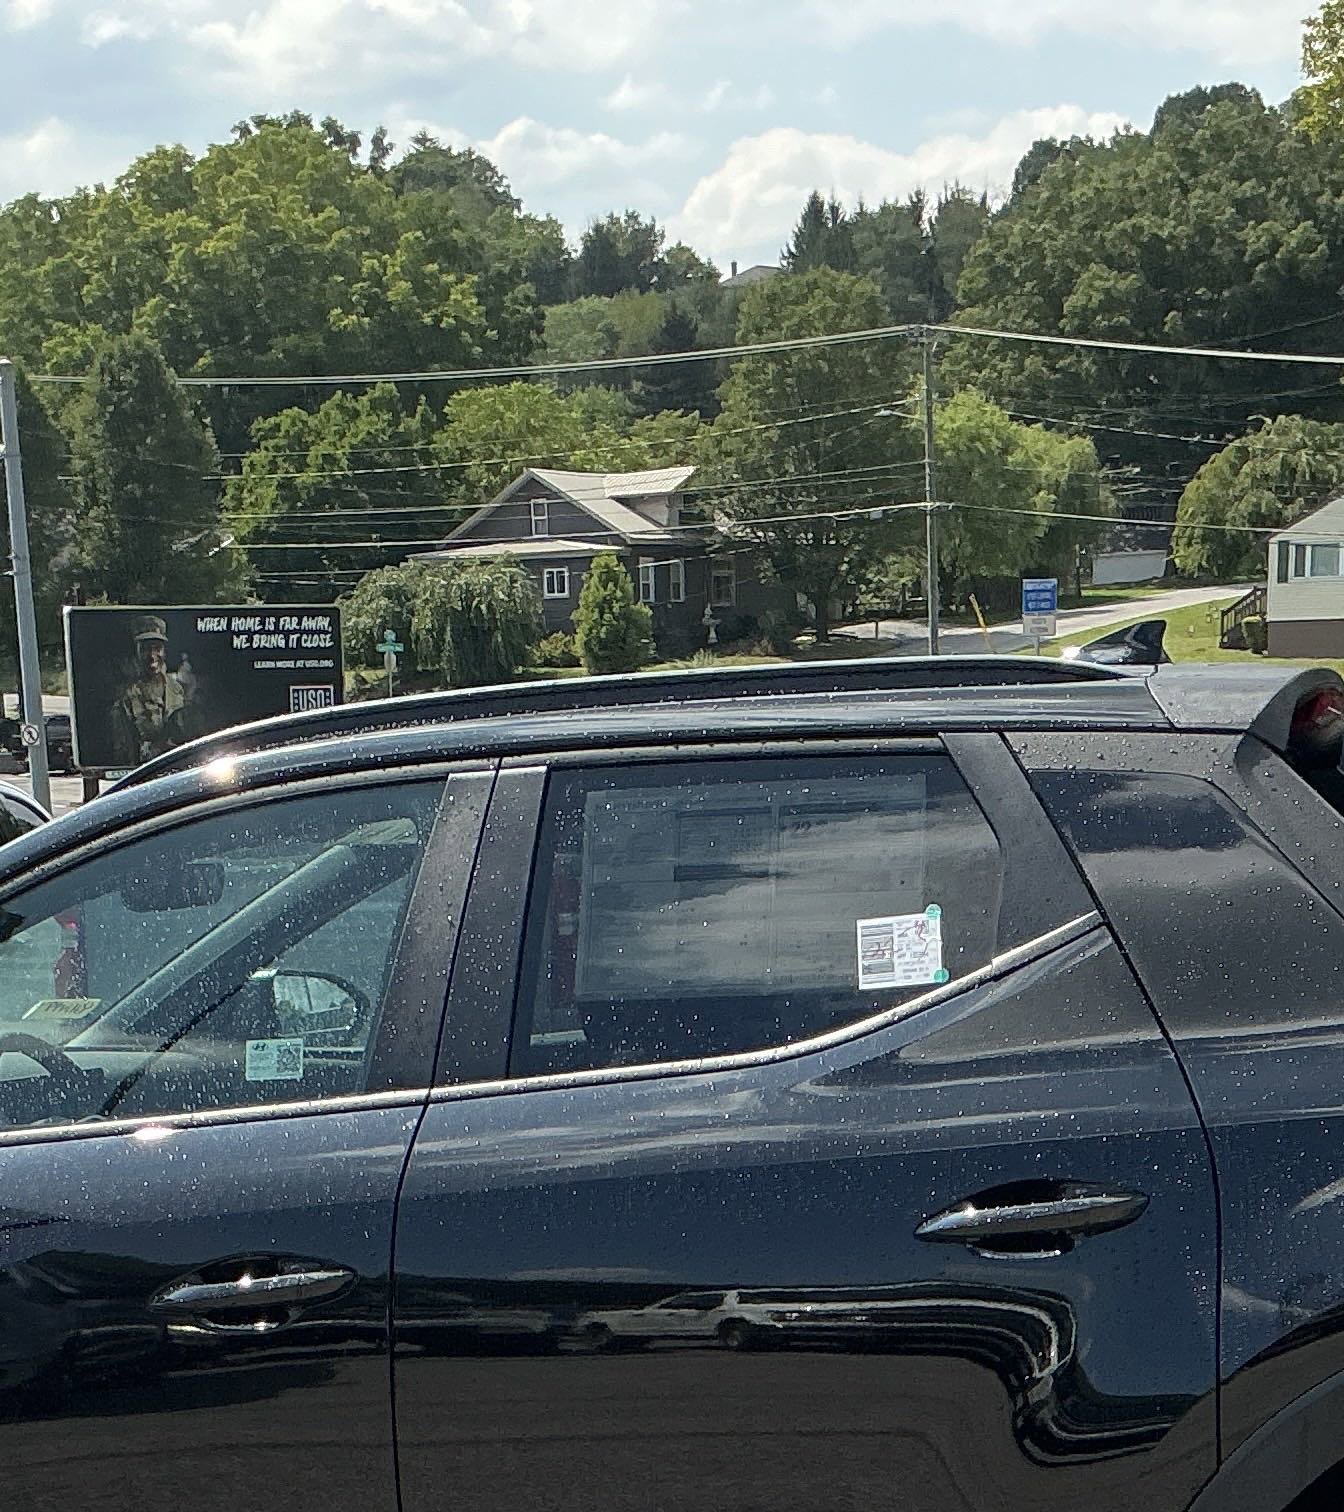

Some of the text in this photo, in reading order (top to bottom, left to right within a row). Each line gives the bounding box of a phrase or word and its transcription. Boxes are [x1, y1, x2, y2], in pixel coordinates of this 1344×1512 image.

[197, 615, 332, 632] WHEN HOME IS FAR AWAY,
[233, 633, 334, 650] WE BRING IT CLOSE
[298, 689, 325, 711] USO
